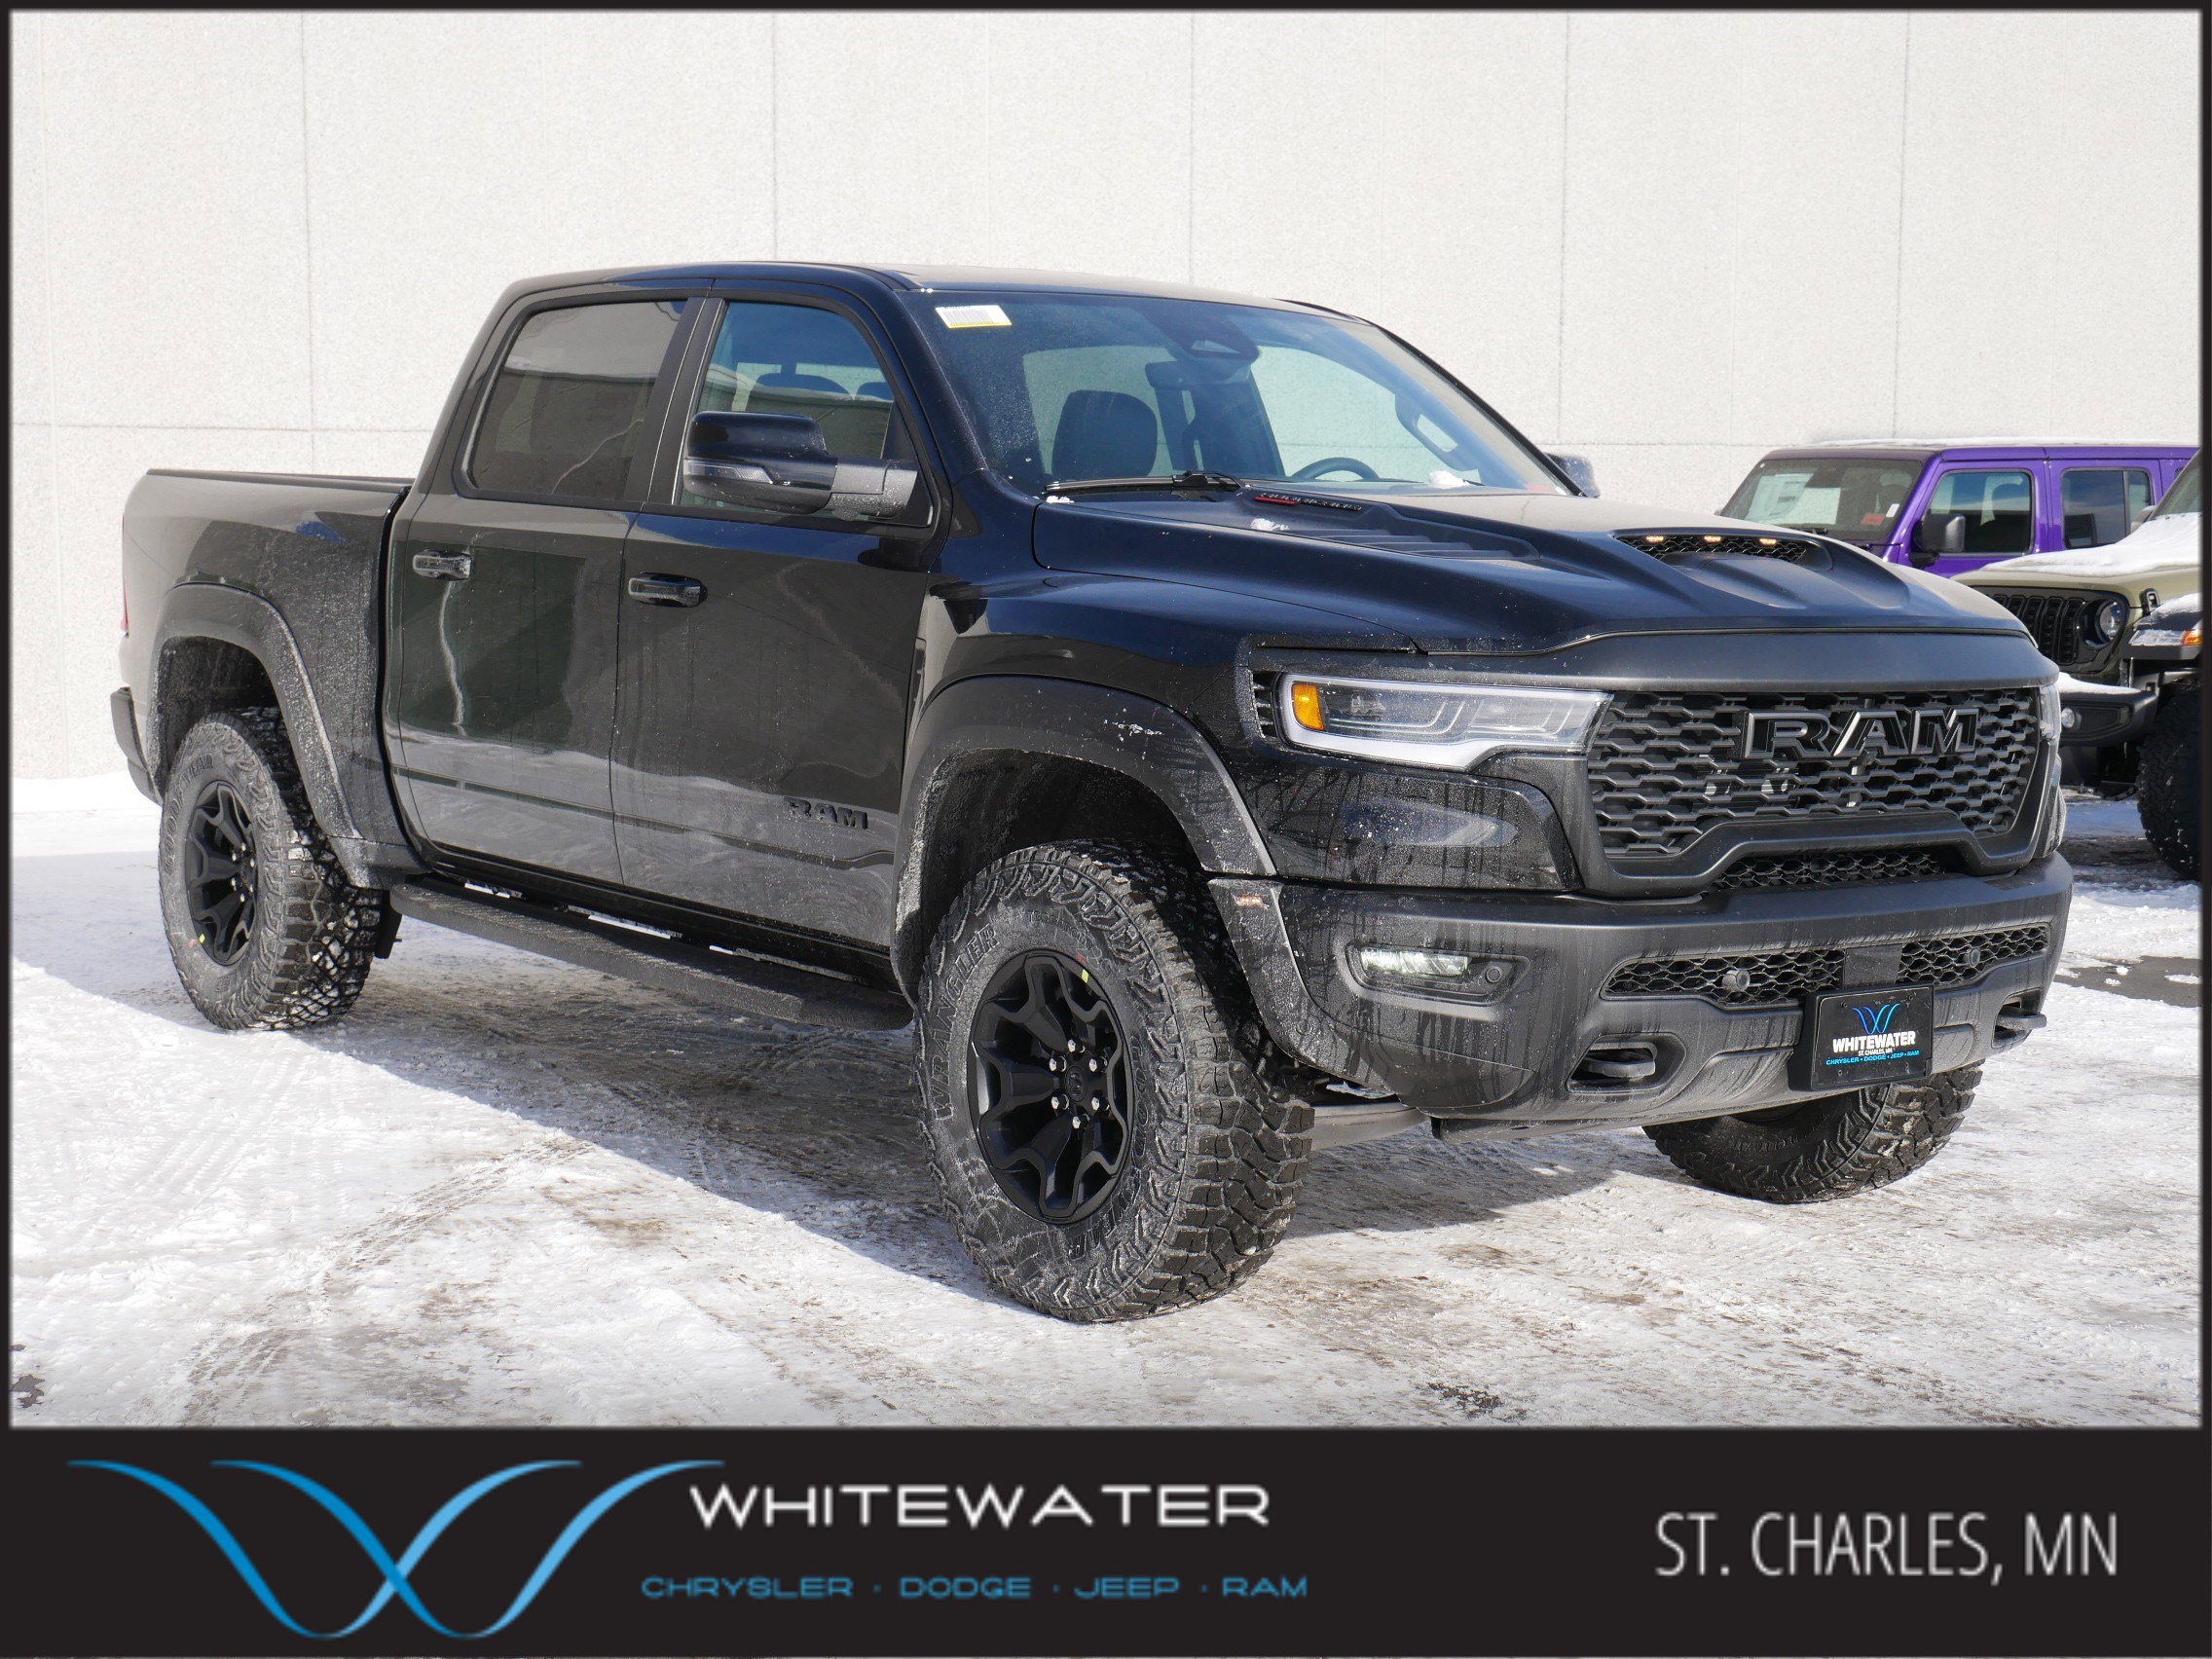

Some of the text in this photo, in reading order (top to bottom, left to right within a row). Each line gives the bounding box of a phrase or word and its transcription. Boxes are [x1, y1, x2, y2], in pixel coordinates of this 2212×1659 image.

[1744, 708, 1979, 758] RAM
[783, 795, 868, 830] RAM
[931, 923, 1000, 1121] WRANGLER
[1832, 1031, 1916, 1053] WHITEWATER
[1825, 1056, 1860, 1066] CHRYSLER
